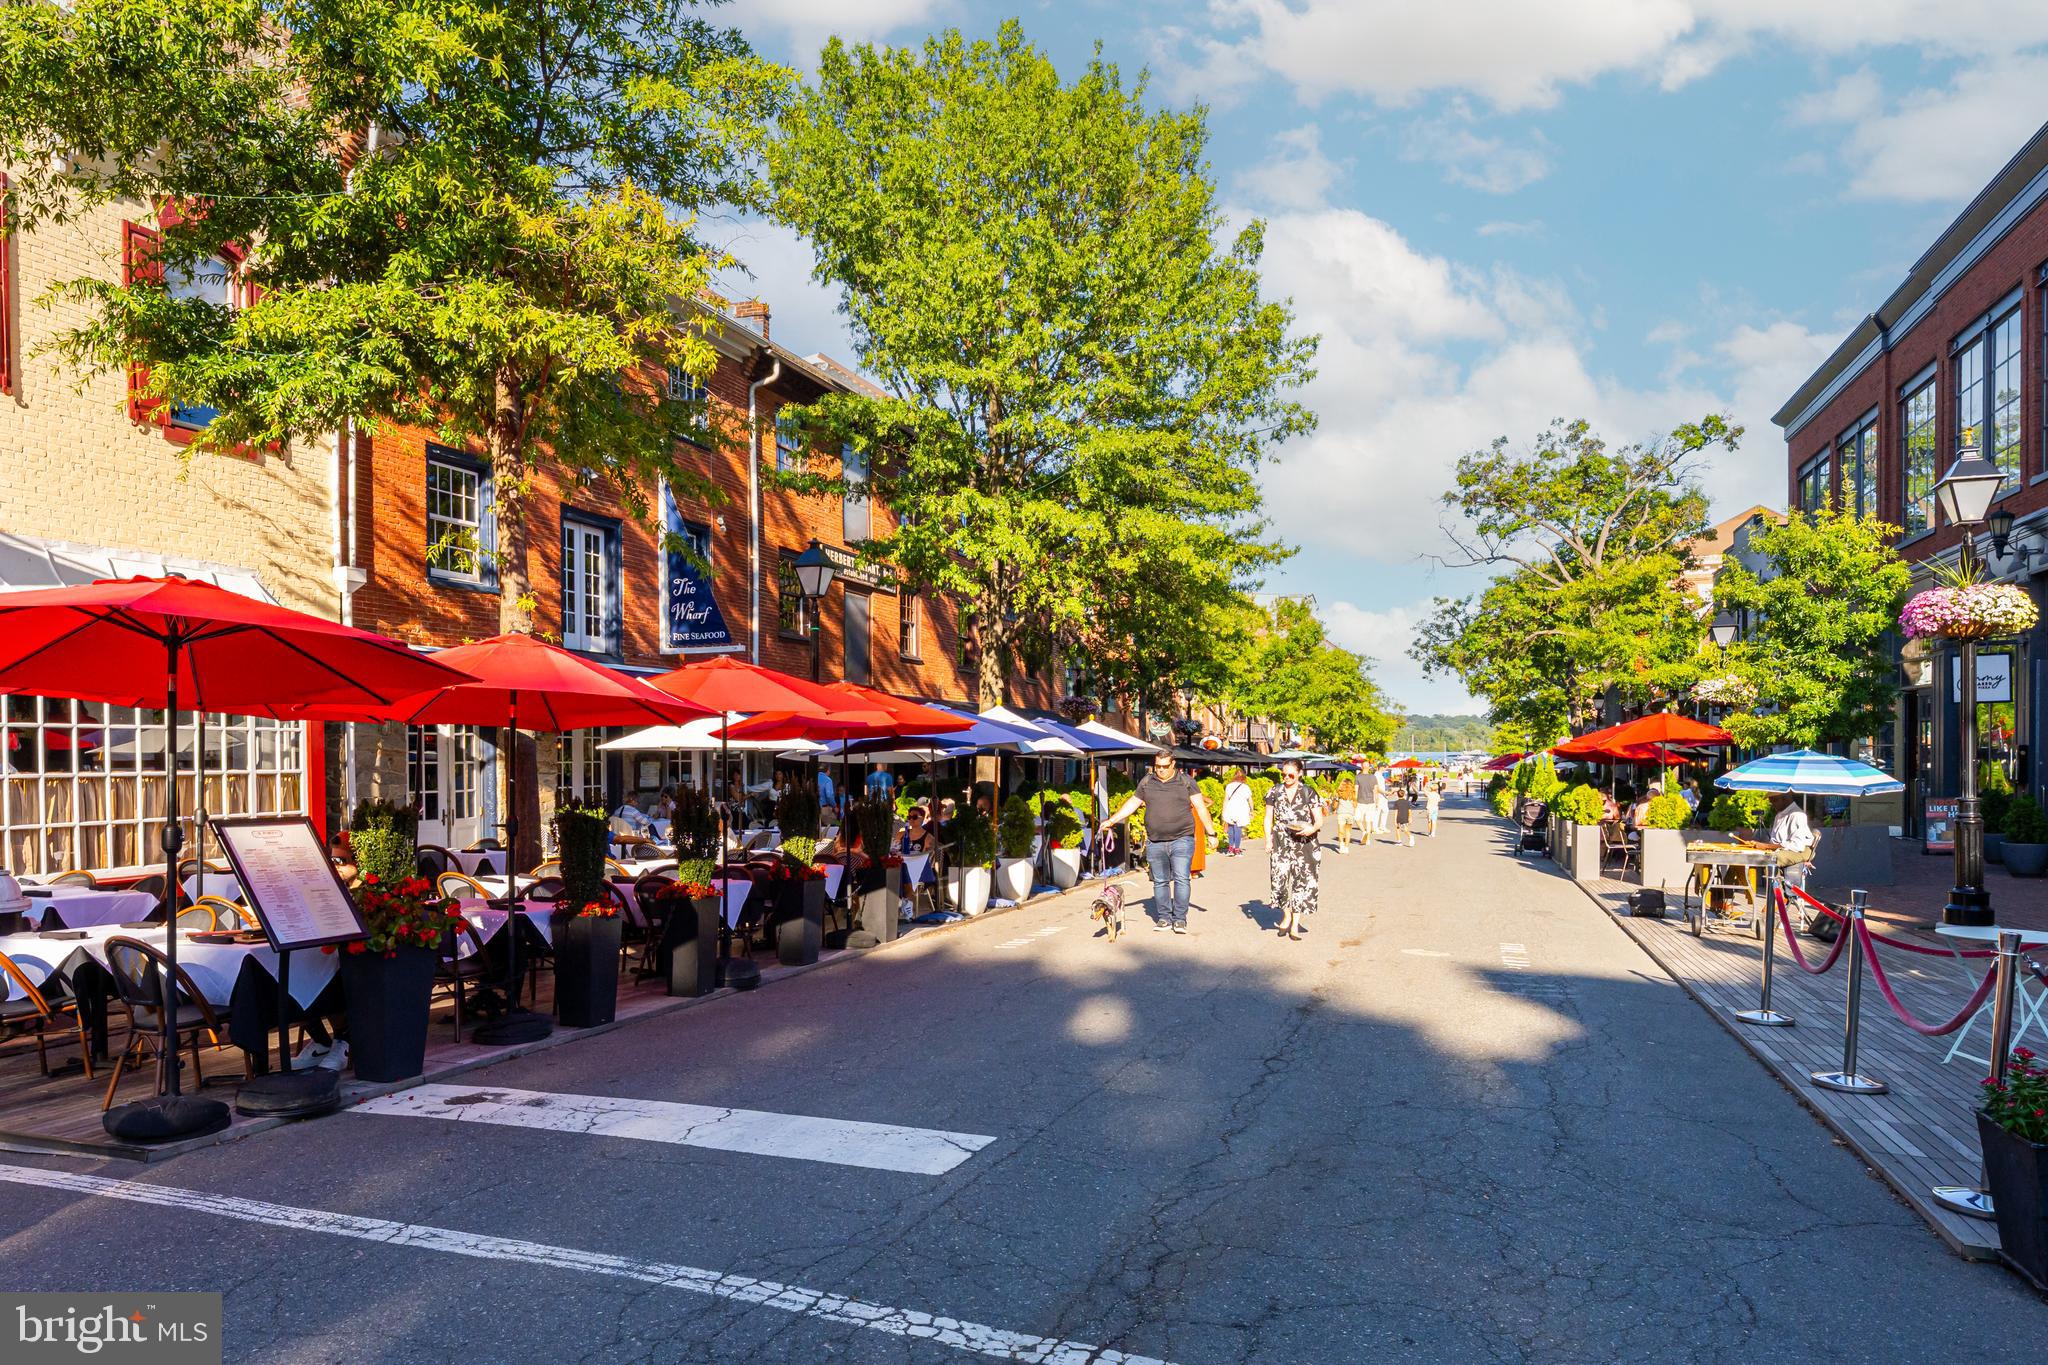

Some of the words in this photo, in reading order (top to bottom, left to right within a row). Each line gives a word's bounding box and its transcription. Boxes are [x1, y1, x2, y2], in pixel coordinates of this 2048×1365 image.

[673, 578, 696, 596] The
[671, 601, 712, 624] Wharf
[673, 632, 689, 641] FINE
[691, 631, 726, 640] SEAFOOD
